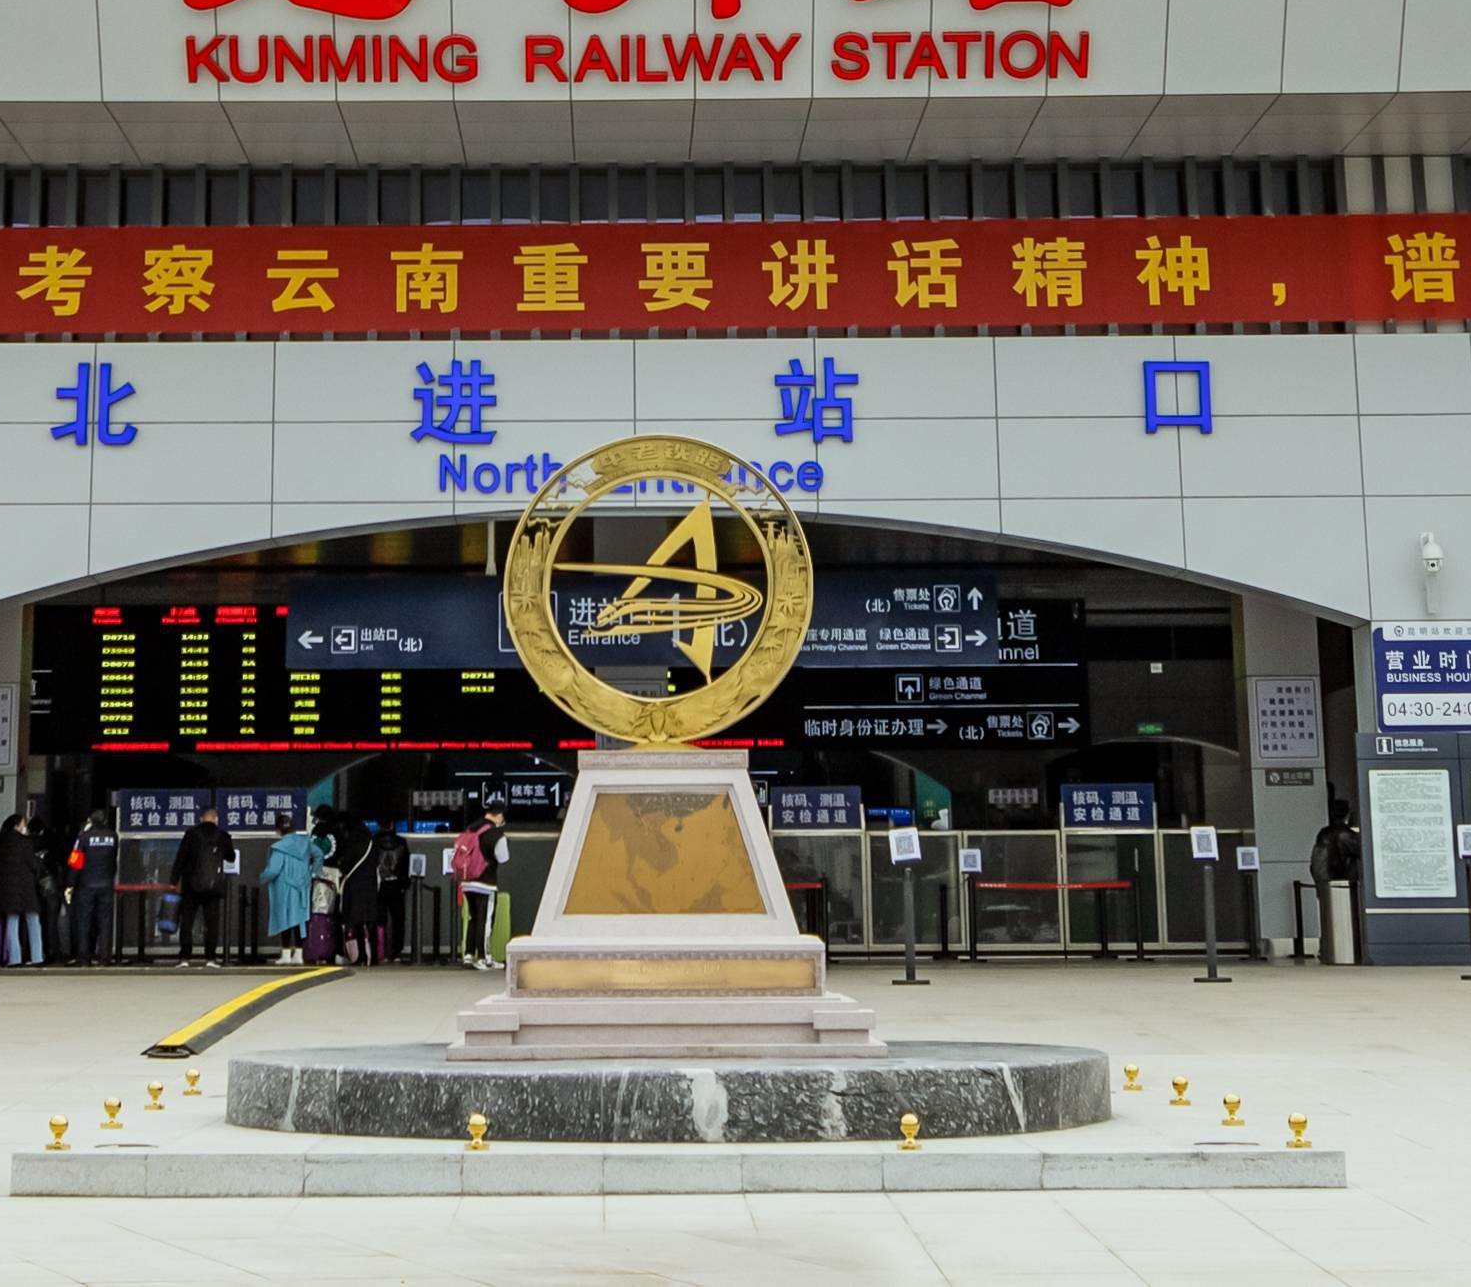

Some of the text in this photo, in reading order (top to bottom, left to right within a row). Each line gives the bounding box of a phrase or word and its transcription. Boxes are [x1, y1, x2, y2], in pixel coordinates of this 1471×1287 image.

[185, 30, 1091, 84] KUNMING RAILWAY STATION
[50, 356, 1214, 446] 北进站口
[439, 452, 567, 494] North
[894, 588, 930, 604] 售票处
[361, 628, 400, 641] 出站口
[879, 628, 930, 641] 绿色通道
[929, 677, 981, 690] 绿色通道
[1386, 672, 1442, 682] BUSINESS
[805, 719, 923, 736] 临时身份证办理
[987, 716, 1023, 731] 售票处
[512, 785, 545, 796] 候车室
